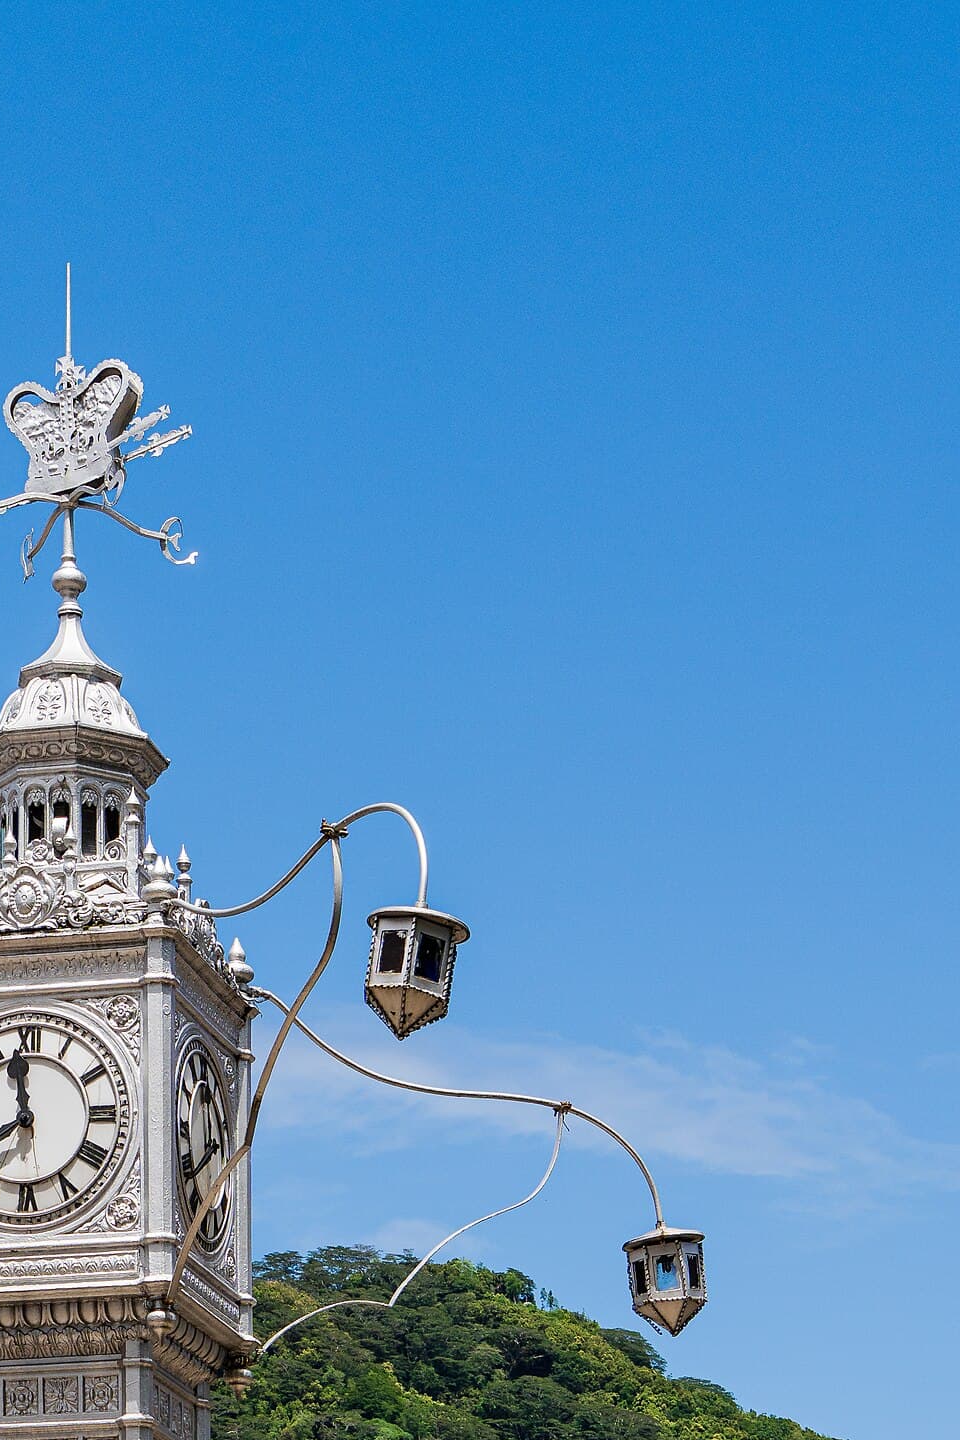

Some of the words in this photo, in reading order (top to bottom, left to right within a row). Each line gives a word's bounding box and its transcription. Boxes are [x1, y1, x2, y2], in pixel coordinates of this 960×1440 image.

[17, 1026, 42, 1054] XII
[80, 1062, 107, 1088] II
[89, 1104, 117, 1123] III
[17, 1183, 39, 1213] VI
[58, 1172, 80, 1202] V
